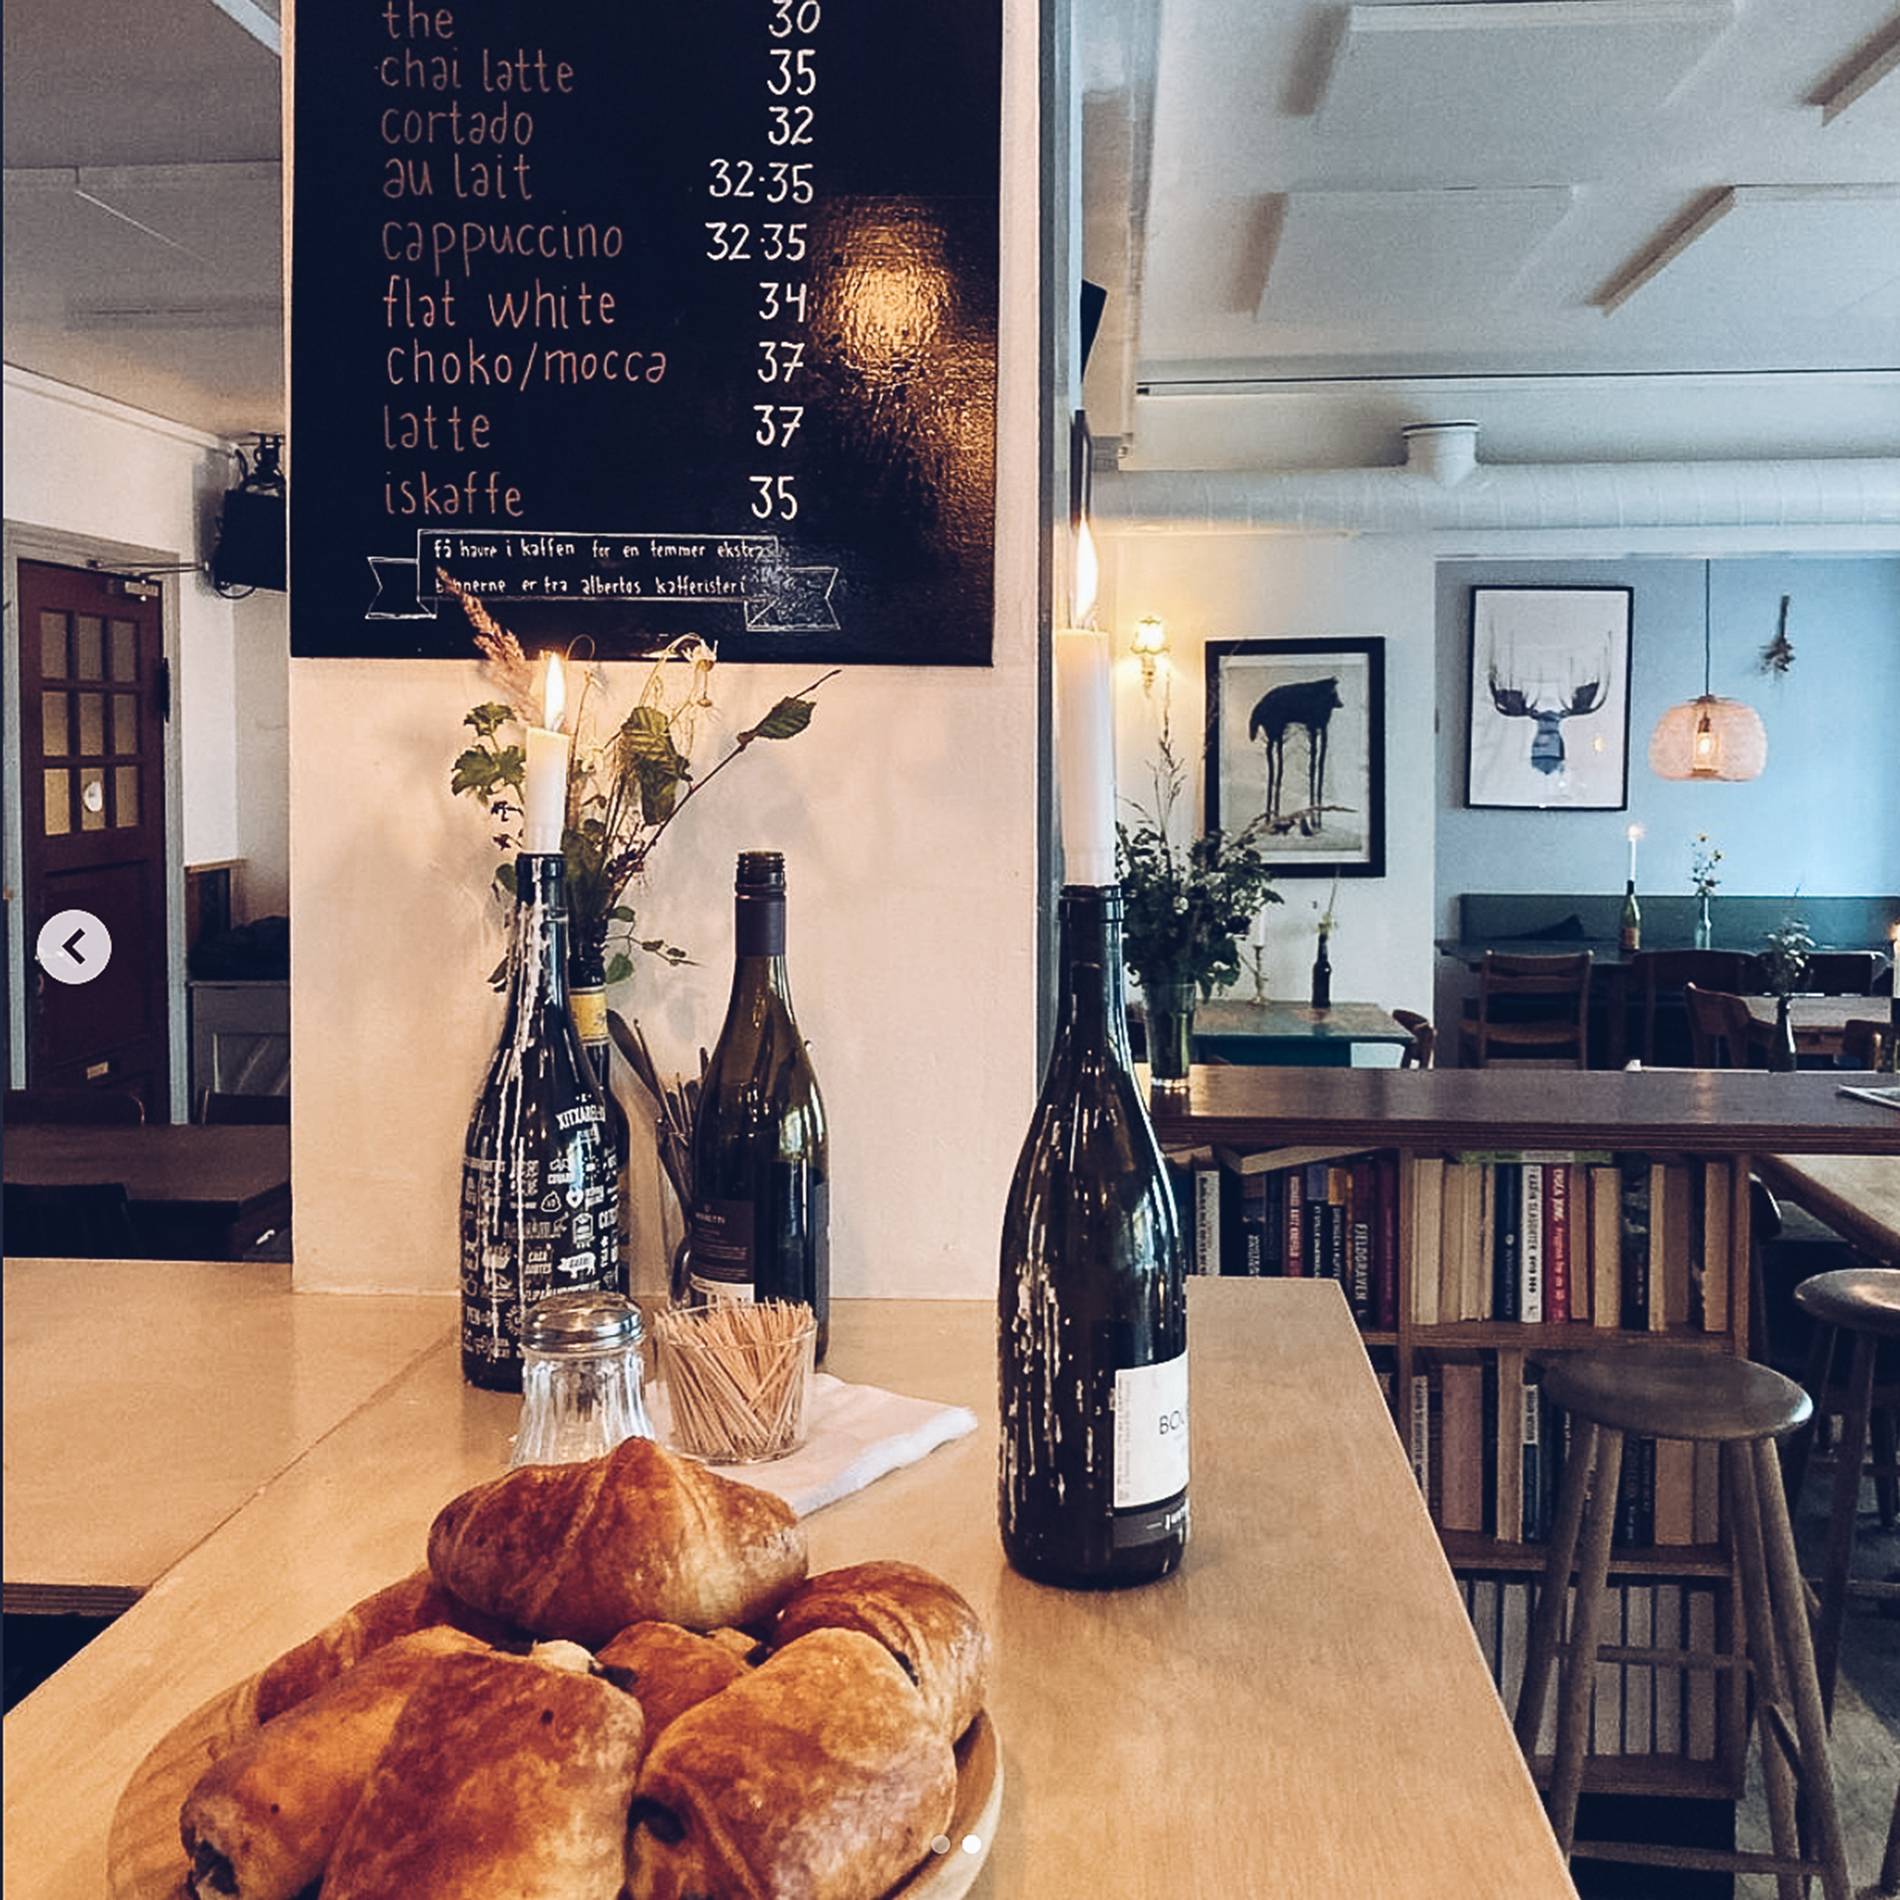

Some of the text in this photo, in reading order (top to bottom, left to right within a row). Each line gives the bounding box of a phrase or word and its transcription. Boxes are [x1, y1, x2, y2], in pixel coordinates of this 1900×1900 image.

[382, 0, 820, 39] the 30
[381, 47, 816, 95] chai latte 35
[382, 101, 814, 146] cortado 32
[383, 158, 433, 199] au
[454, 153, 532, 200] lait
[382, 211, 622, 277] cappuccino
[383, 274, 807, 329] flat white 34
[387, 339, 805, 392] choko/mocca 37
[384, 405, 804, 452] latte 37
[386, 471, 798, 520] iskaffe 35
[434, 537, 453, 559] få
[520, 537, 576, 558] kaffen
[621, 543, 640, 558] en
[521, 577, 539, 594] er
[1159, 1410, 1185, 1435] BO
